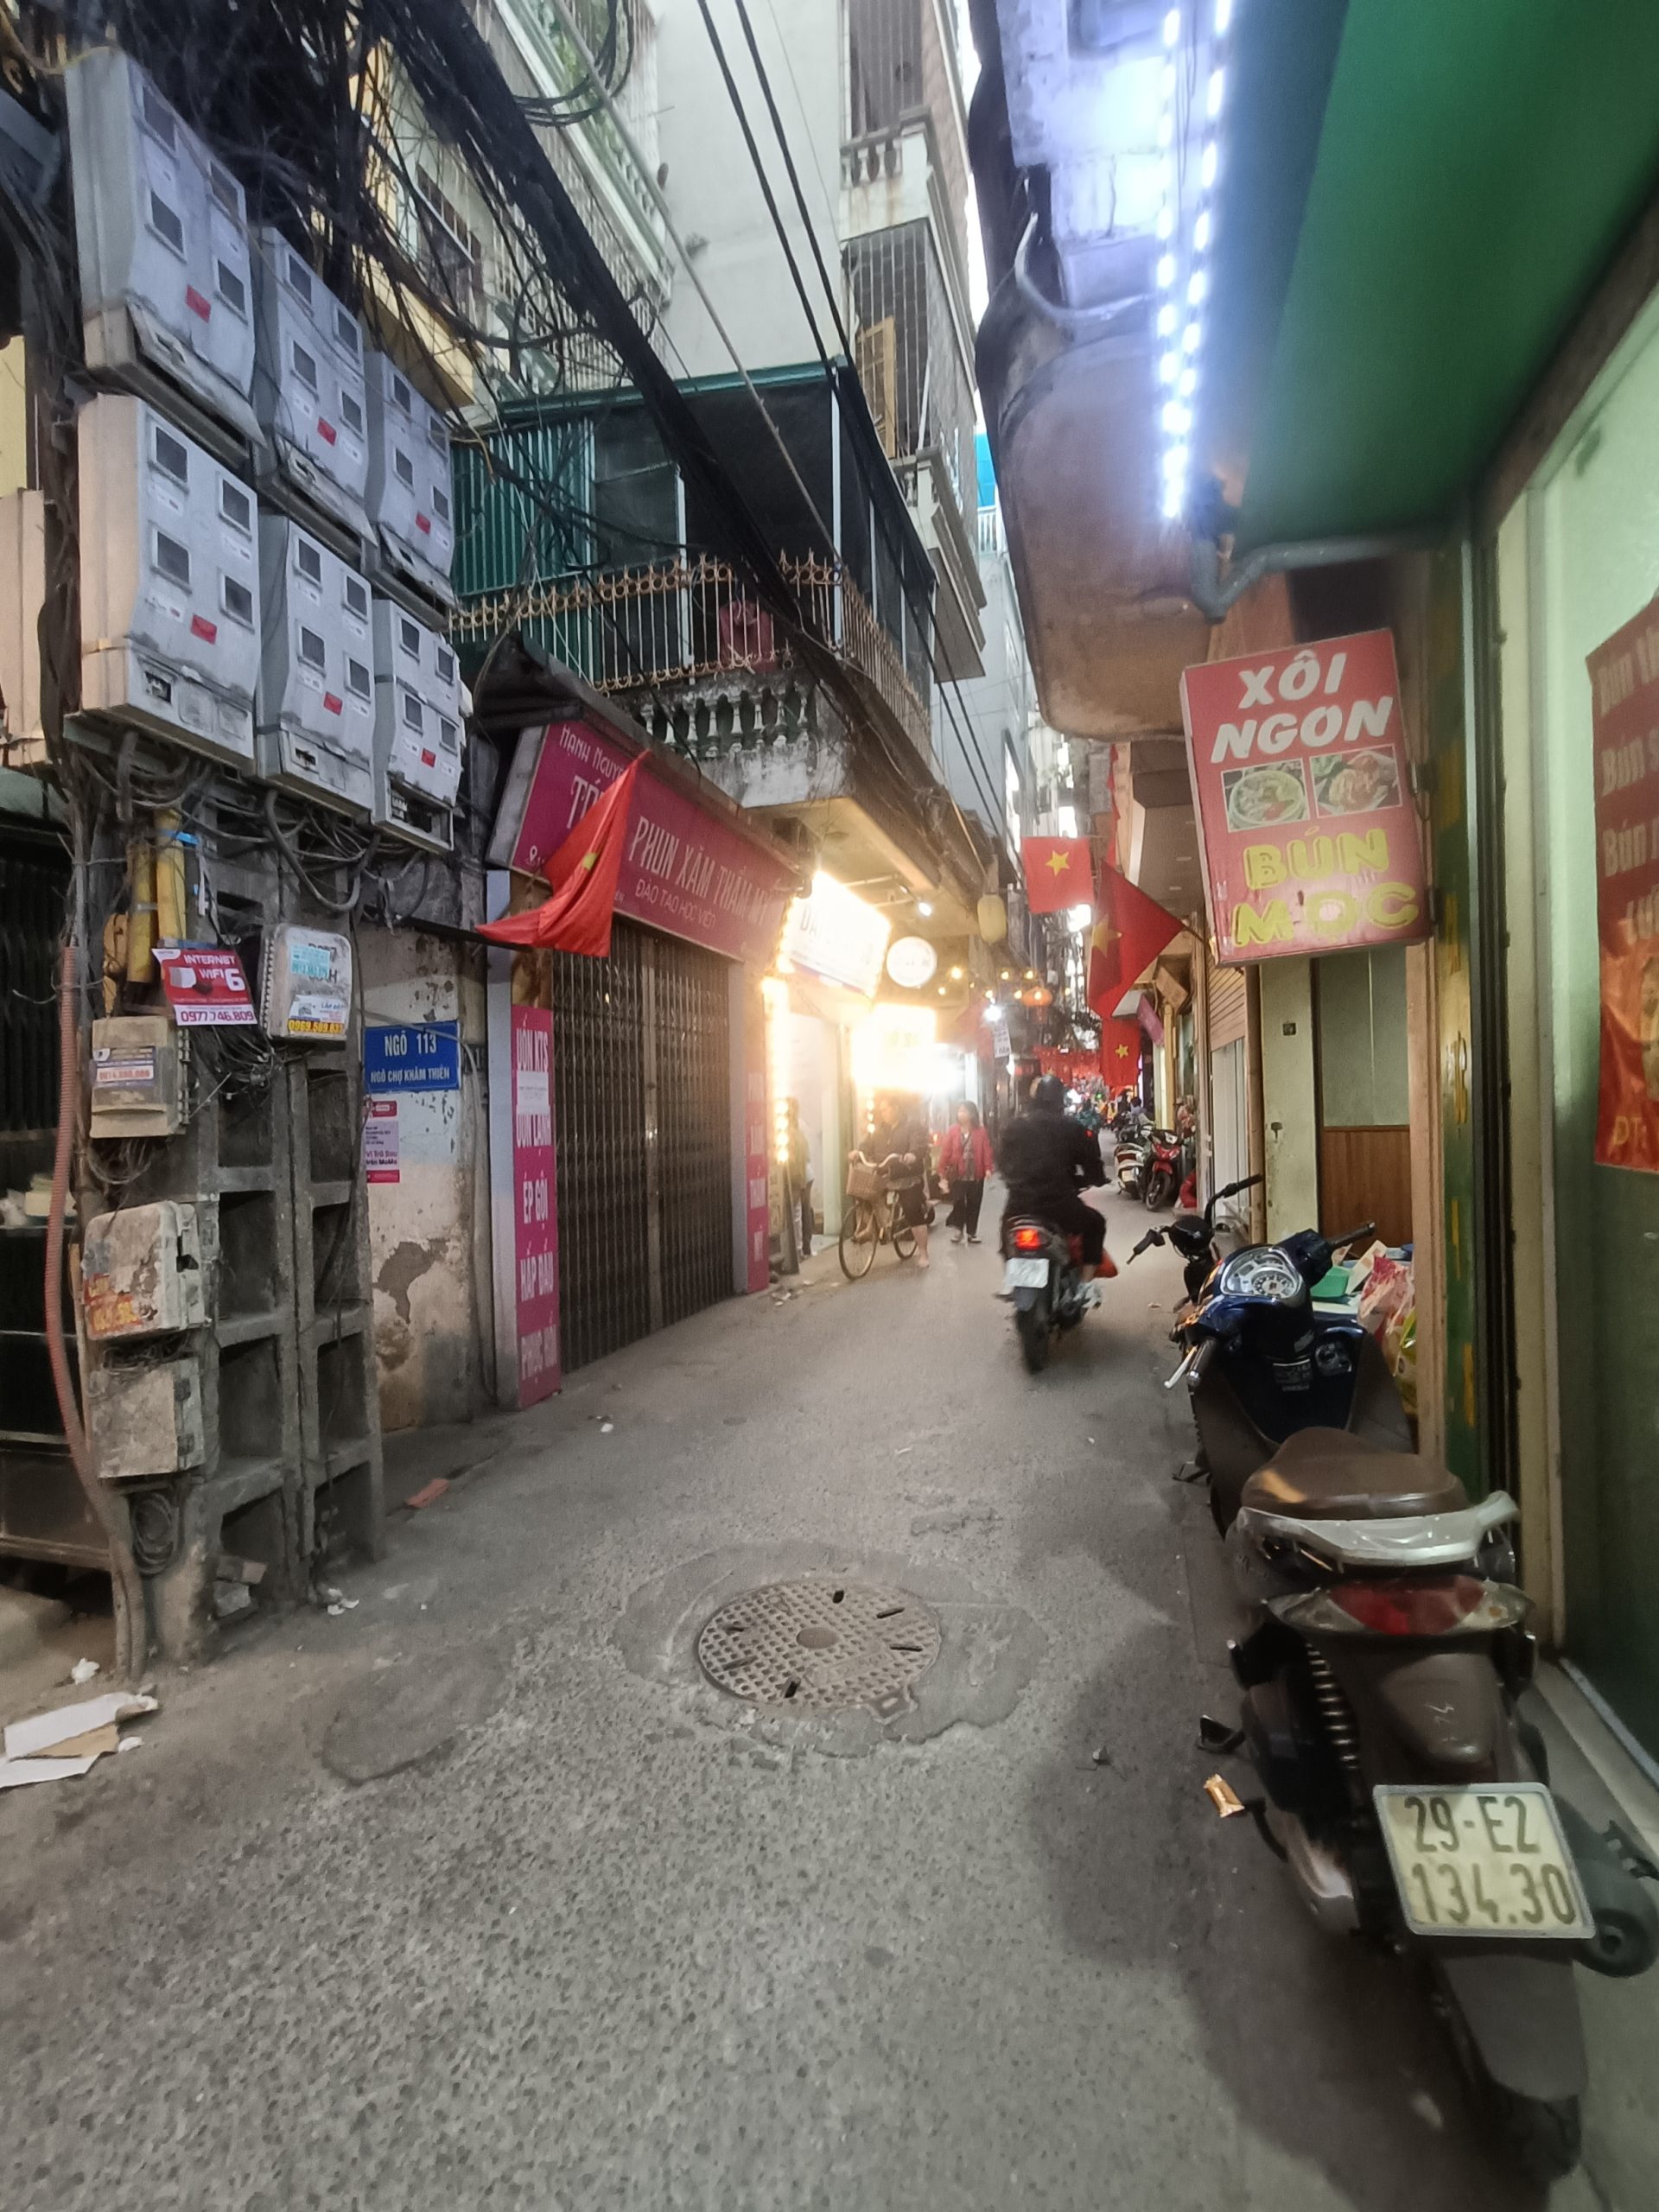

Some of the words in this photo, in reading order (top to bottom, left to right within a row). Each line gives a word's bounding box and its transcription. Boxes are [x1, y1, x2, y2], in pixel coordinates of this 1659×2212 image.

[1238, 650, 1347, 709] XÔI
[1211, 696, 1393, 763] NGON
[629, 816, 679, 880] PHUN
[675, 845, 715, 899] XĂM
[1243, 825, 1389, 890] BÚN
[1231, 882, 1418, 947] MỌC
[183, 954, 235, 965] INTERNET
[198, 969, 224, 979] WIFI
[225, 968, 245, 991] 6
[385, 1030, 408, 1057] NGÕ
[416, 1033, 436, 1054] 113
[388, 1069, 403, 1085] CHỢ
[404, 1065, 426, 1082] KHÂM
[1404, 1796, 1541, 1853] 29-E2
[1412, 1864, 1575, 1924] 134.30
